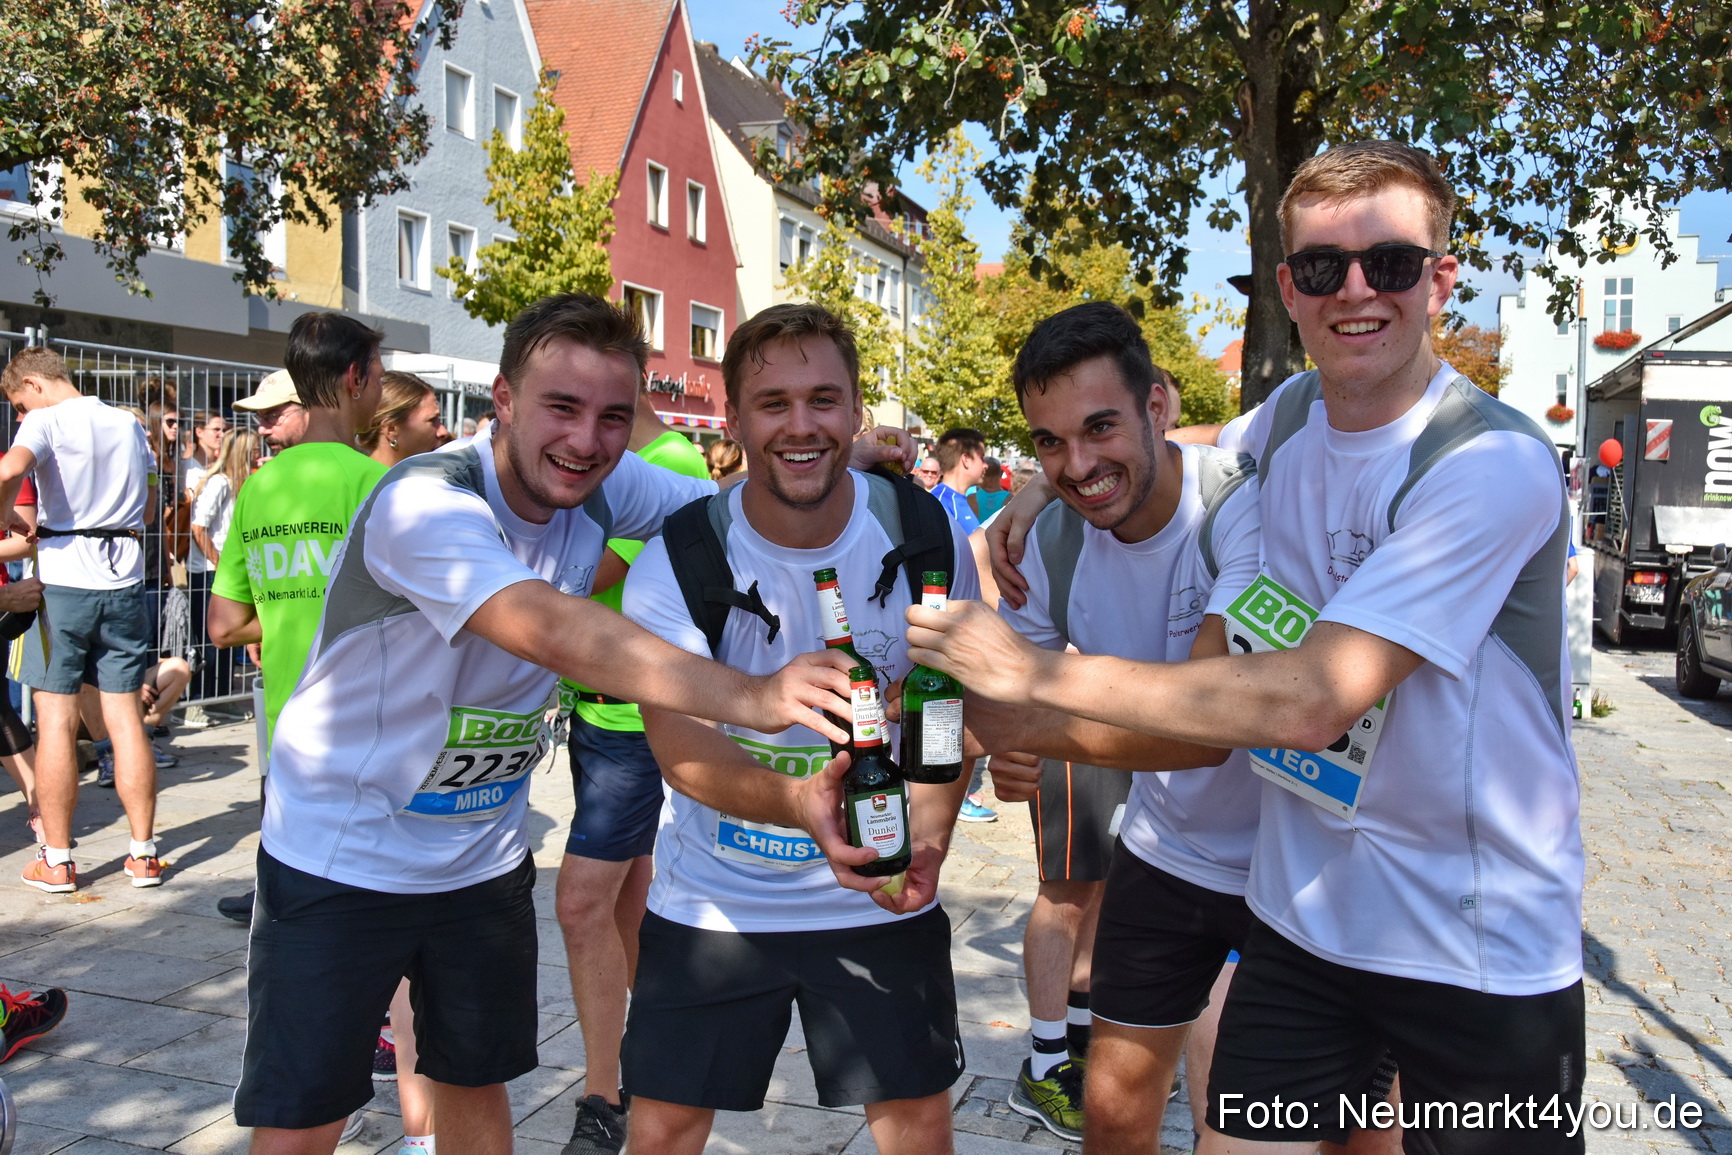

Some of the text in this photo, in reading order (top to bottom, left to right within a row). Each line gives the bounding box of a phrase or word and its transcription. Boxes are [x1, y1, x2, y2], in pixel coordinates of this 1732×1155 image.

[242, 522, 343, 543] EAM ALPENVEREIN
[263, 539, 344, 580] DAV
[1243, 588, 1310, 645] BO
[1361, 718, 1372, 730] D
[454, 785, 503, 811] MIRO
[866, 816, 897, 825] Lammsbräu
[868, 824, 899, 836] Dunkel
